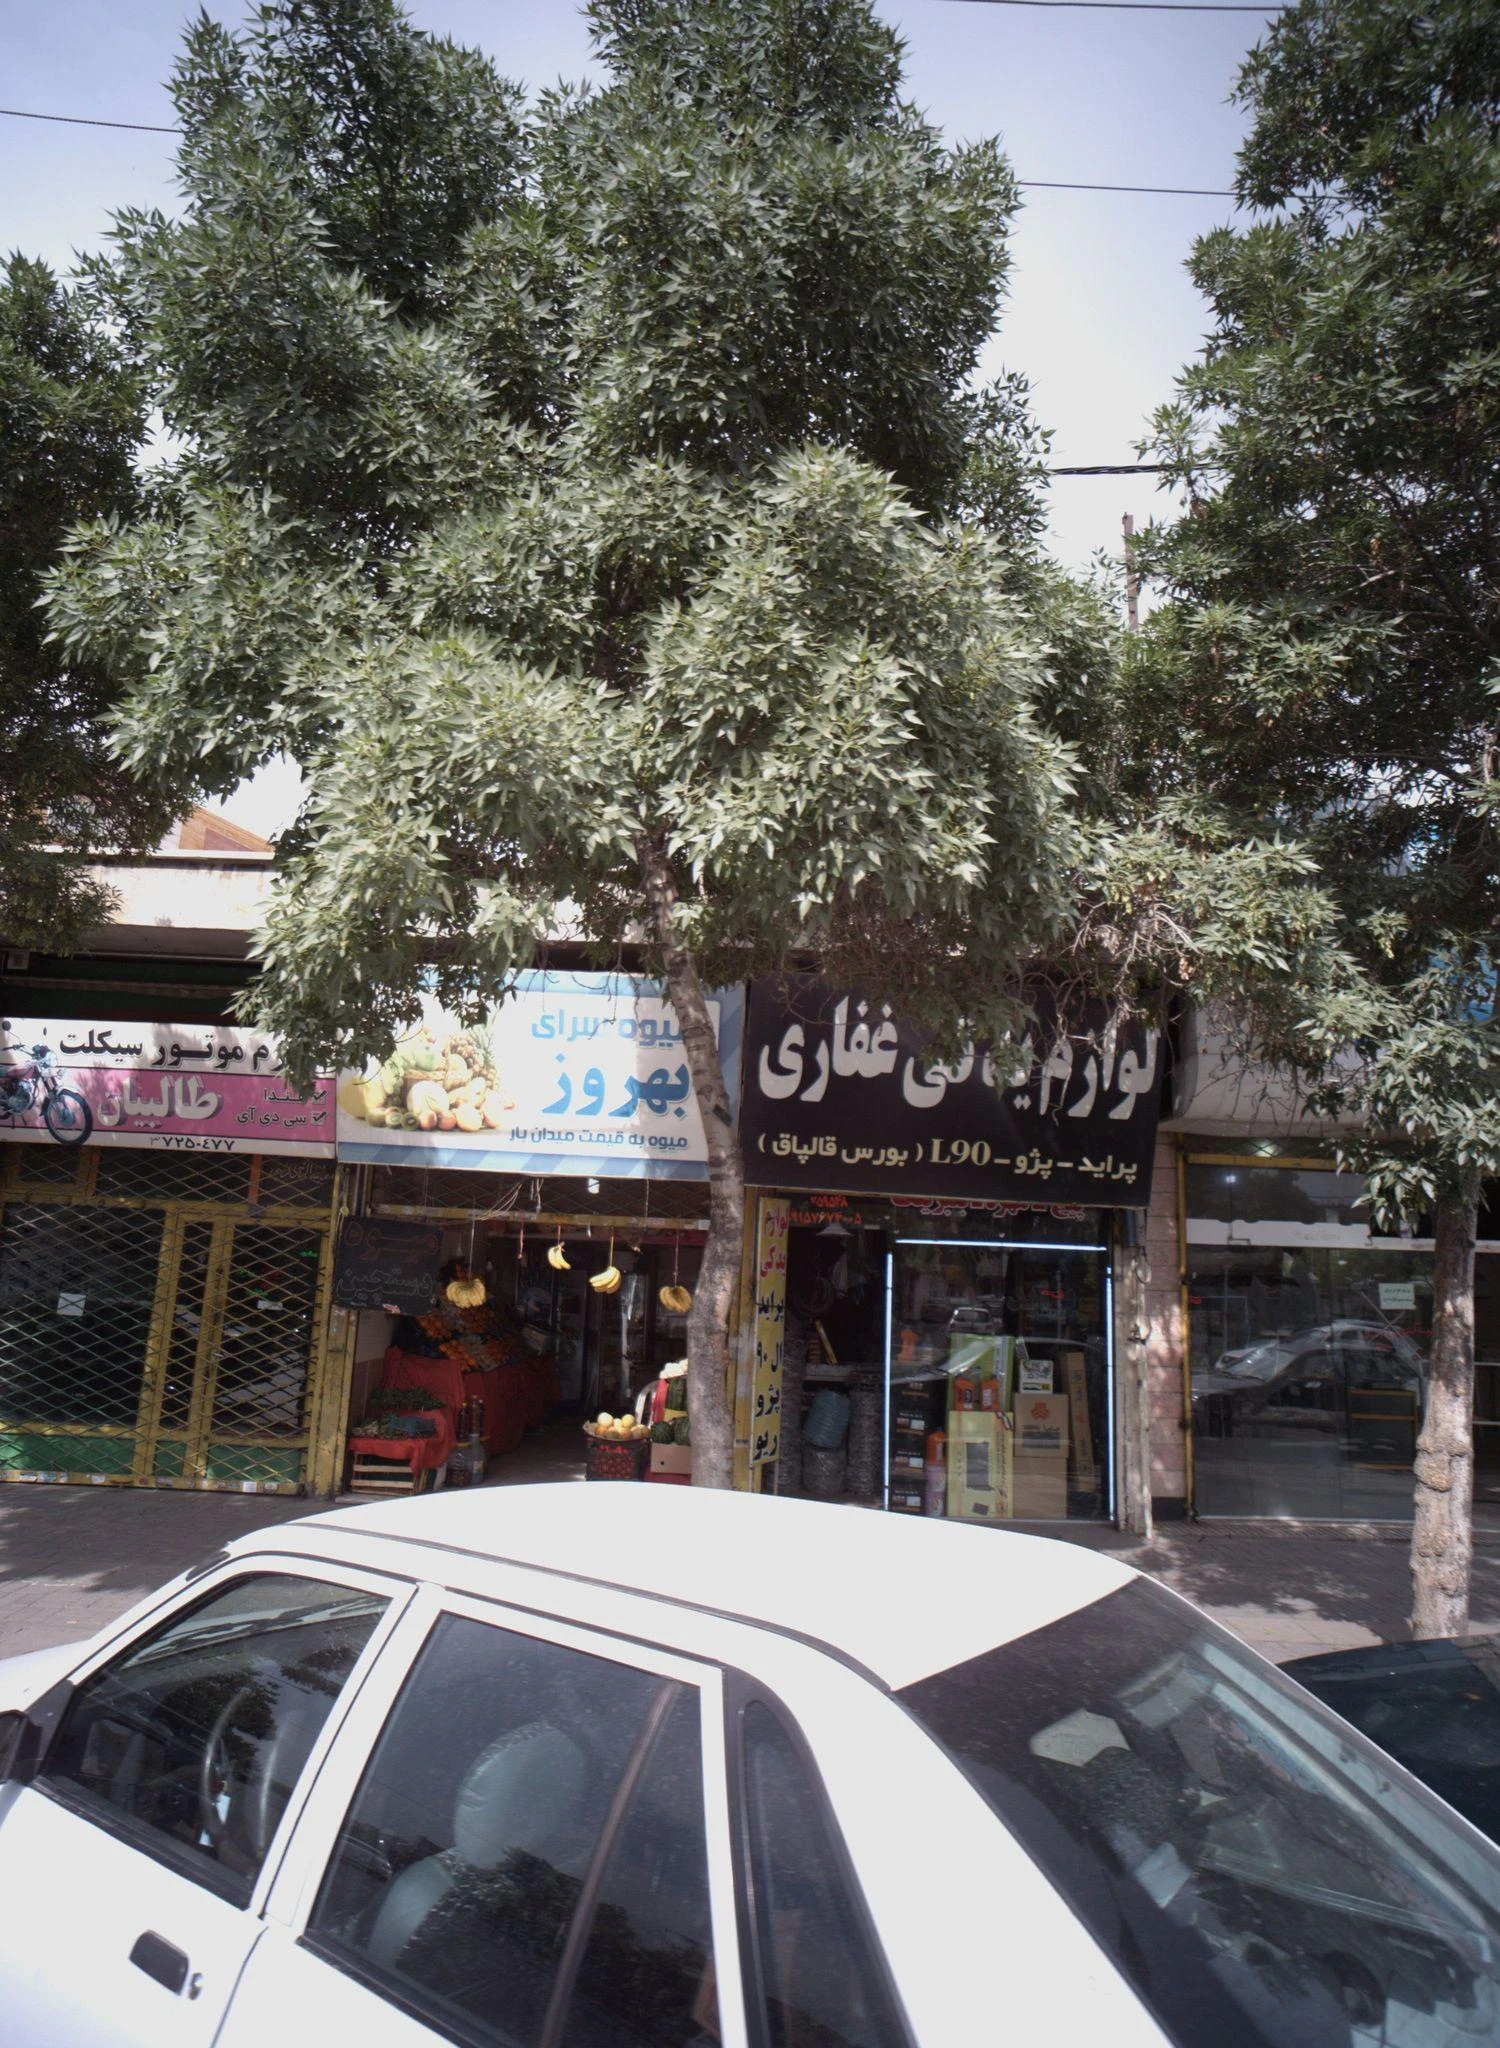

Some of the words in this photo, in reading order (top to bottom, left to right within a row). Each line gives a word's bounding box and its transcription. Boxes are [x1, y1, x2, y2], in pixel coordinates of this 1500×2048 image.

[618, 1018, 687, 1047] یوه
[59, 1029, 143, 1062] سیکلت
[759, 996, 899, 1102] غفاری
[541, 1053, 690, 1119] بهروز
[237, 1106, 256, 1124] آی
[259, 1112, 279, 1125] دی
[284, 1116, 306, 1127] سی
[509, 1126, 528, 1142] بار
[531, 1127, 575, 1143] میدان
[578, 1129, 624, 1147] قیمت
[628, 1132, 645, 1148] به
[649, 1135, 688, 1150] میوه
[929, 1138, 990, 1165] L90
[1014, 1148, 1053, 1179] پژو
[1078, 1155, 1137, 1184] پراید
[755, 1384, 780, 1418] پژو
